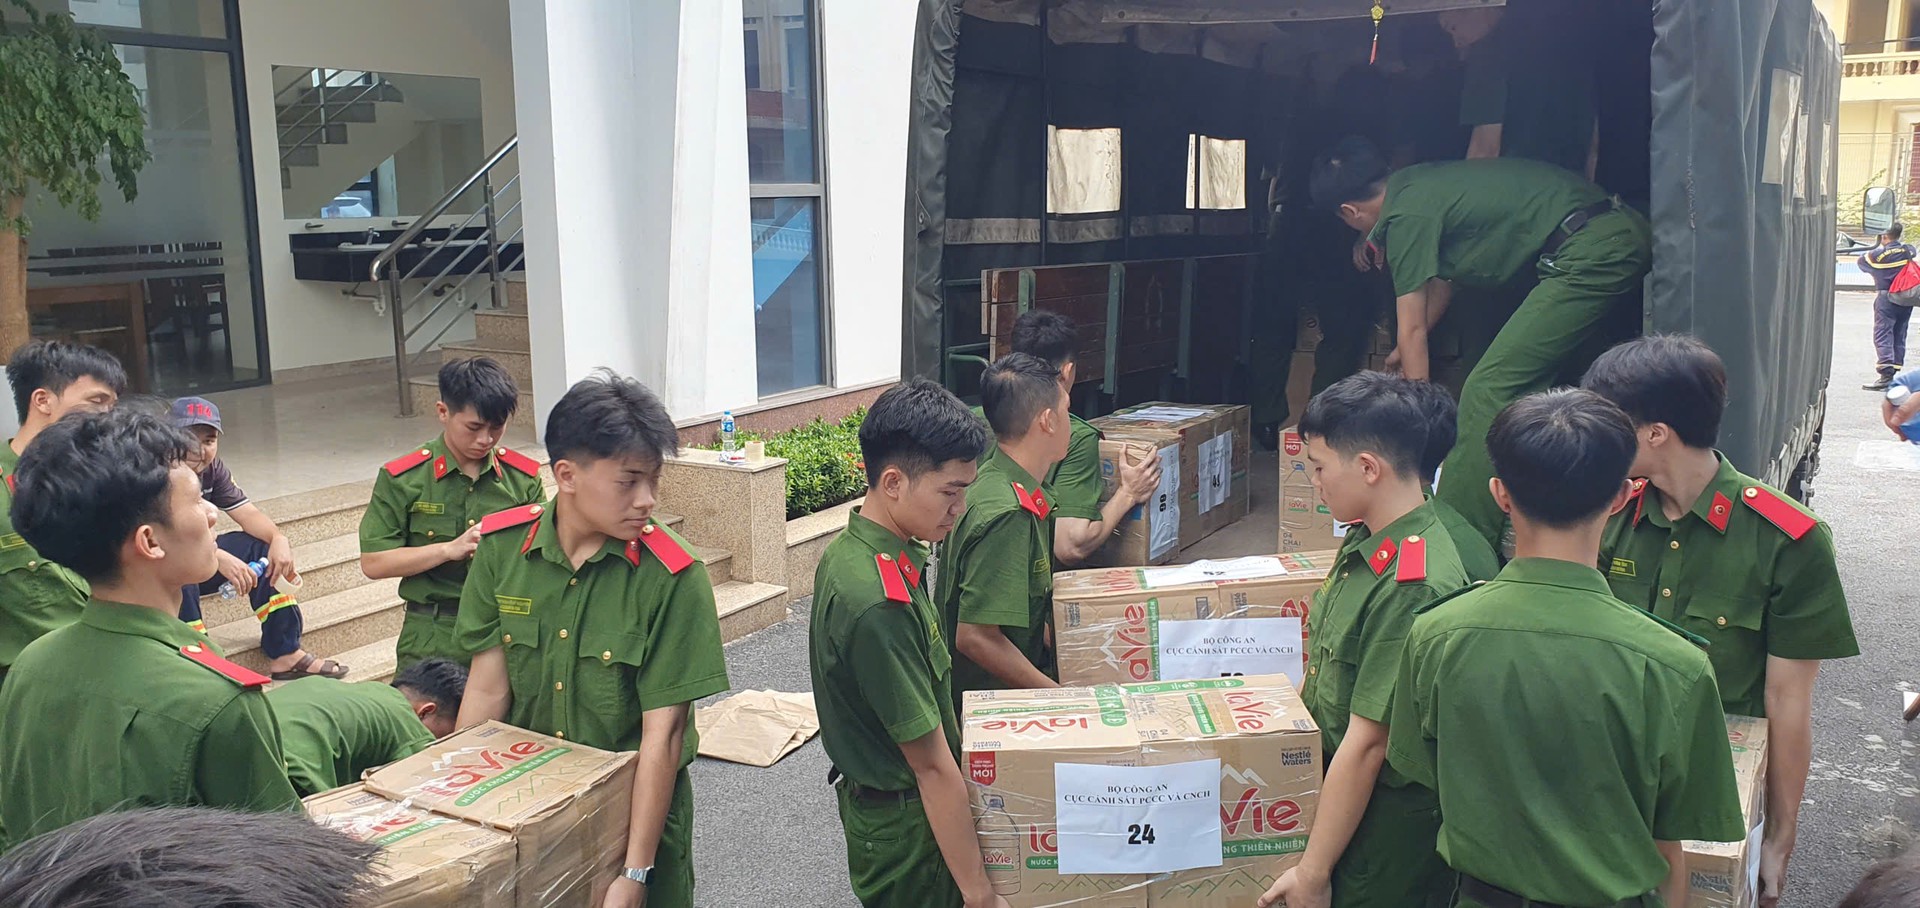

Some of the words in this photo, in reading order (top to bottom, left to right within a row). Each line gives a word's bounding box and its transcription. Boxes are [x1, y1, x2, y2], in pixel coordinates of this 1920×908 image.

[187, 403, 212, 418] 114
[1116, 603, 1150, 681] aVie
[1216, 636, 1242, 645] CÔNG
[1165, 646, 1185, 657] CỤC
[1211, 645, 1229, 655] SÁT
[1268, 646, 1294, 654] CNCH
[1224, 691, 1272, 731] laVie
[981, 717, 1089, 734] laVie
[1281, 750, 1312, 760] Nestlé
[1281, 758, 1312, 766] Waters
[1107, 785, 1121, 795] BỘ
[1123, 784, 1153, 794] CÔNG
[1156, 783, 1169, 793] AN
[1064, 794, 1086, 804] CỤC
[1087, 793, 1116, 804] CẢNH
[1117, 795, 1137, 805] SÁT
[1139, 795, 1166, 805] PCCC
[1167, 791, 1182, 802] VÀ
[1183, 790, 1211, 801] CNCH
[1220, 787, 1302, 835] Vie
[1127, 823, 1156, 845] 24
[1241, 840, 1272, 852] THIÊN
[1274, 838, 1306, 850] NHIÊN
